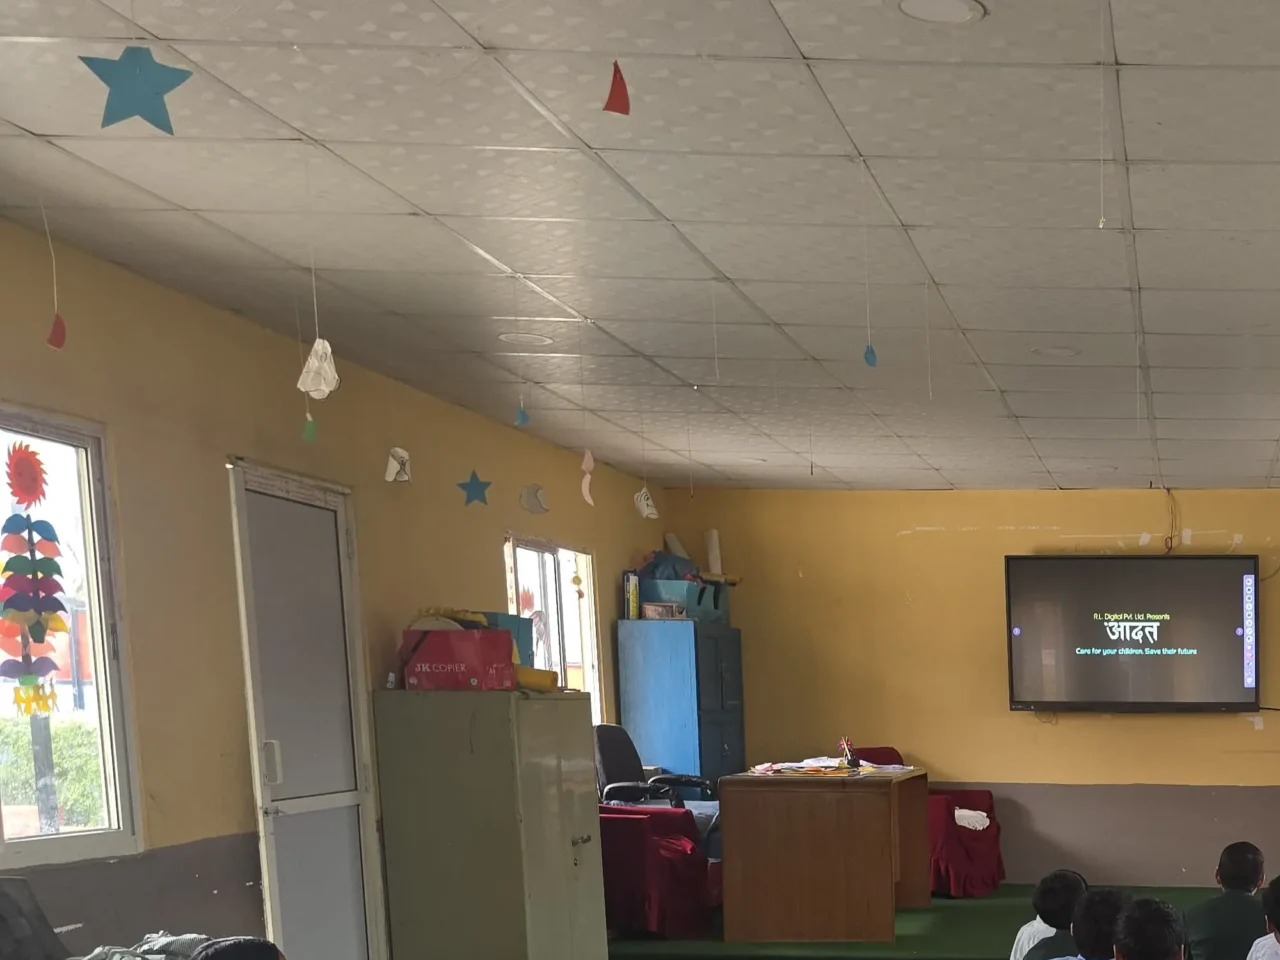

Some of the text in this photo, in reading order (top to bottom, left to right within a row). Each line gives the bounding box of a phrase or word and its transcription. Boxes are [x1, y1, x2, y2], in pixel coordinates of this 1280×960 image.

[1104, 613, 1123, 621] Digital
[1104, 621, 1160, 644] आदत
[1075, 647, 1091, 655] Care
[1092, 647, 1101, 655] for
[1102, 648, 1117, 656] your
[1144, 647, 1161, 655] Save
[1162, 647, 1176, 655] their
[1177, 647, 1197, 655] future
[415, 663, 466, 673] JK COPIER
